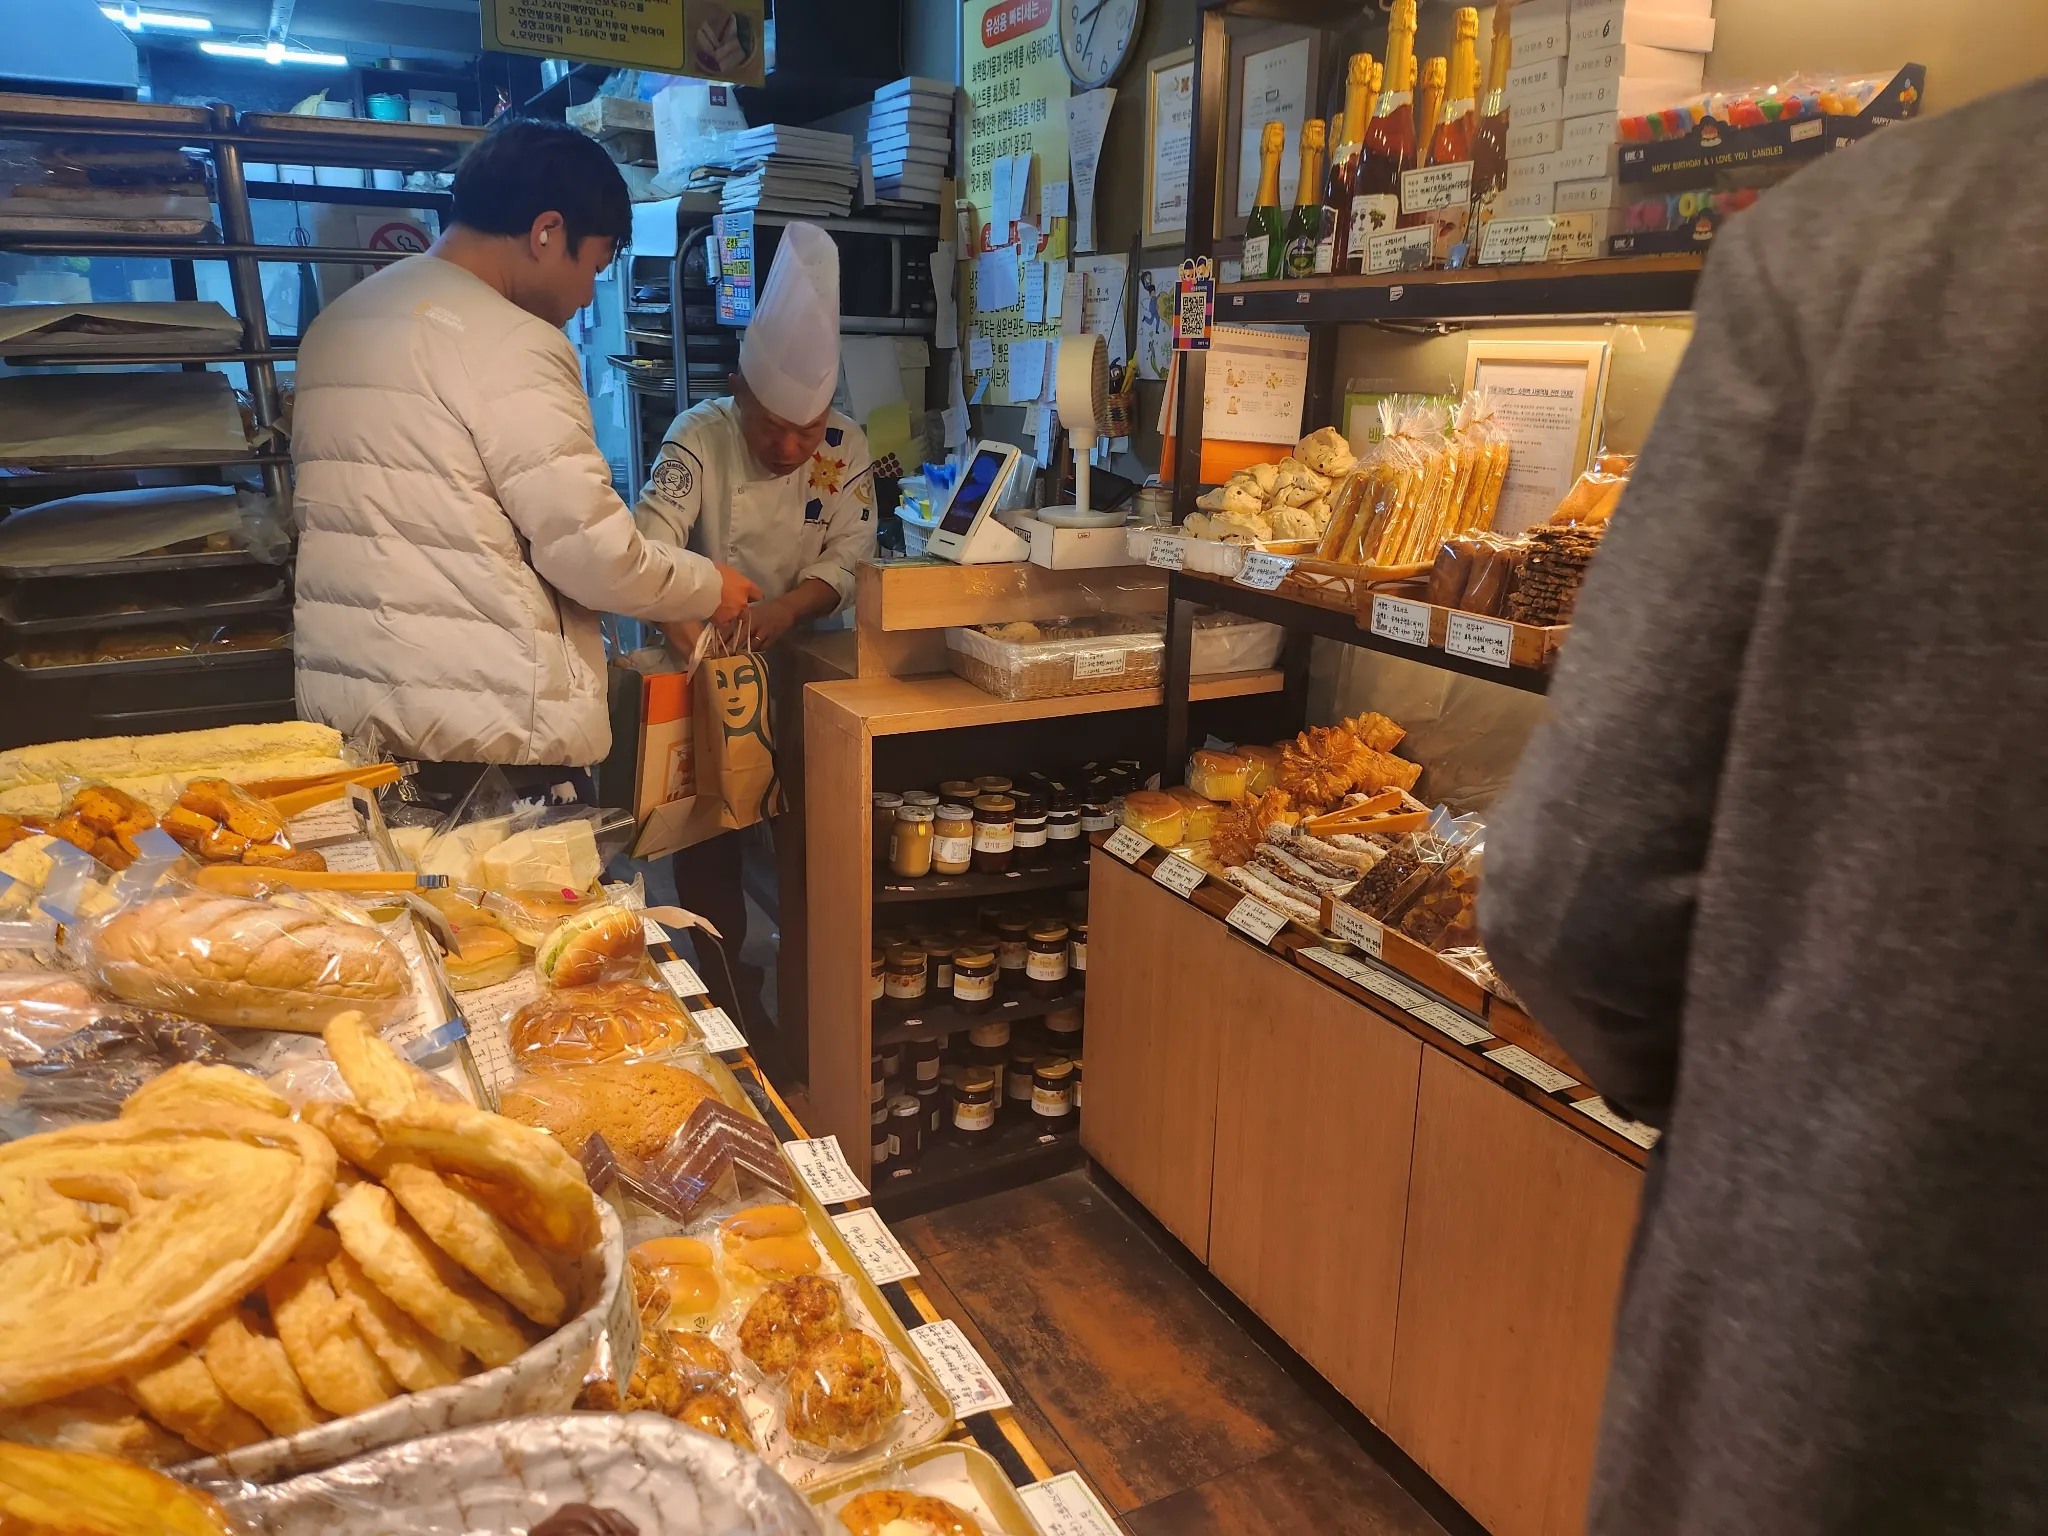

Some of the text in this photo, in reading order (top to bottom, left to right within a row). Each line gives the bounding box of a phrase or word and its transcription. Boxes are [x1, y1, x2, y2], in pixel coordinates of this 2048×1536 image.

[1071, 7, 1079, 25] 9
[518, 18, 565, 35] 냉장고에서
[985, 12, 1008, 38] 유성용
[1075, 33, 1083, 54] 8
[1547, 36, 1554, 49] 9
[1003, 45, 1025, 75] 방부제를
[1086, 52, 1093, 72] 7
[1100, 54, 1108, 75] 6
[1605, 55, 1612, 68] 9
[1598, 122, 1604, 134] 7
[1587, 154, 1594, 166] 7
[1652, 163, 1672, 173] HAPPY
[1672, 157, 1701, 171] BIRTHDAY
[1703, 157, 1709, 166] &
[1715, 153, 1732, 164] LOVE
[1734, 151, 1748, 161] YOU
[1752, 145, 1784, 158] CANDLES
[1539, 163, 1545, 175] 3
[1535, 194, 1541, 206] 3
[1590, 188, 1597, 200] 6
